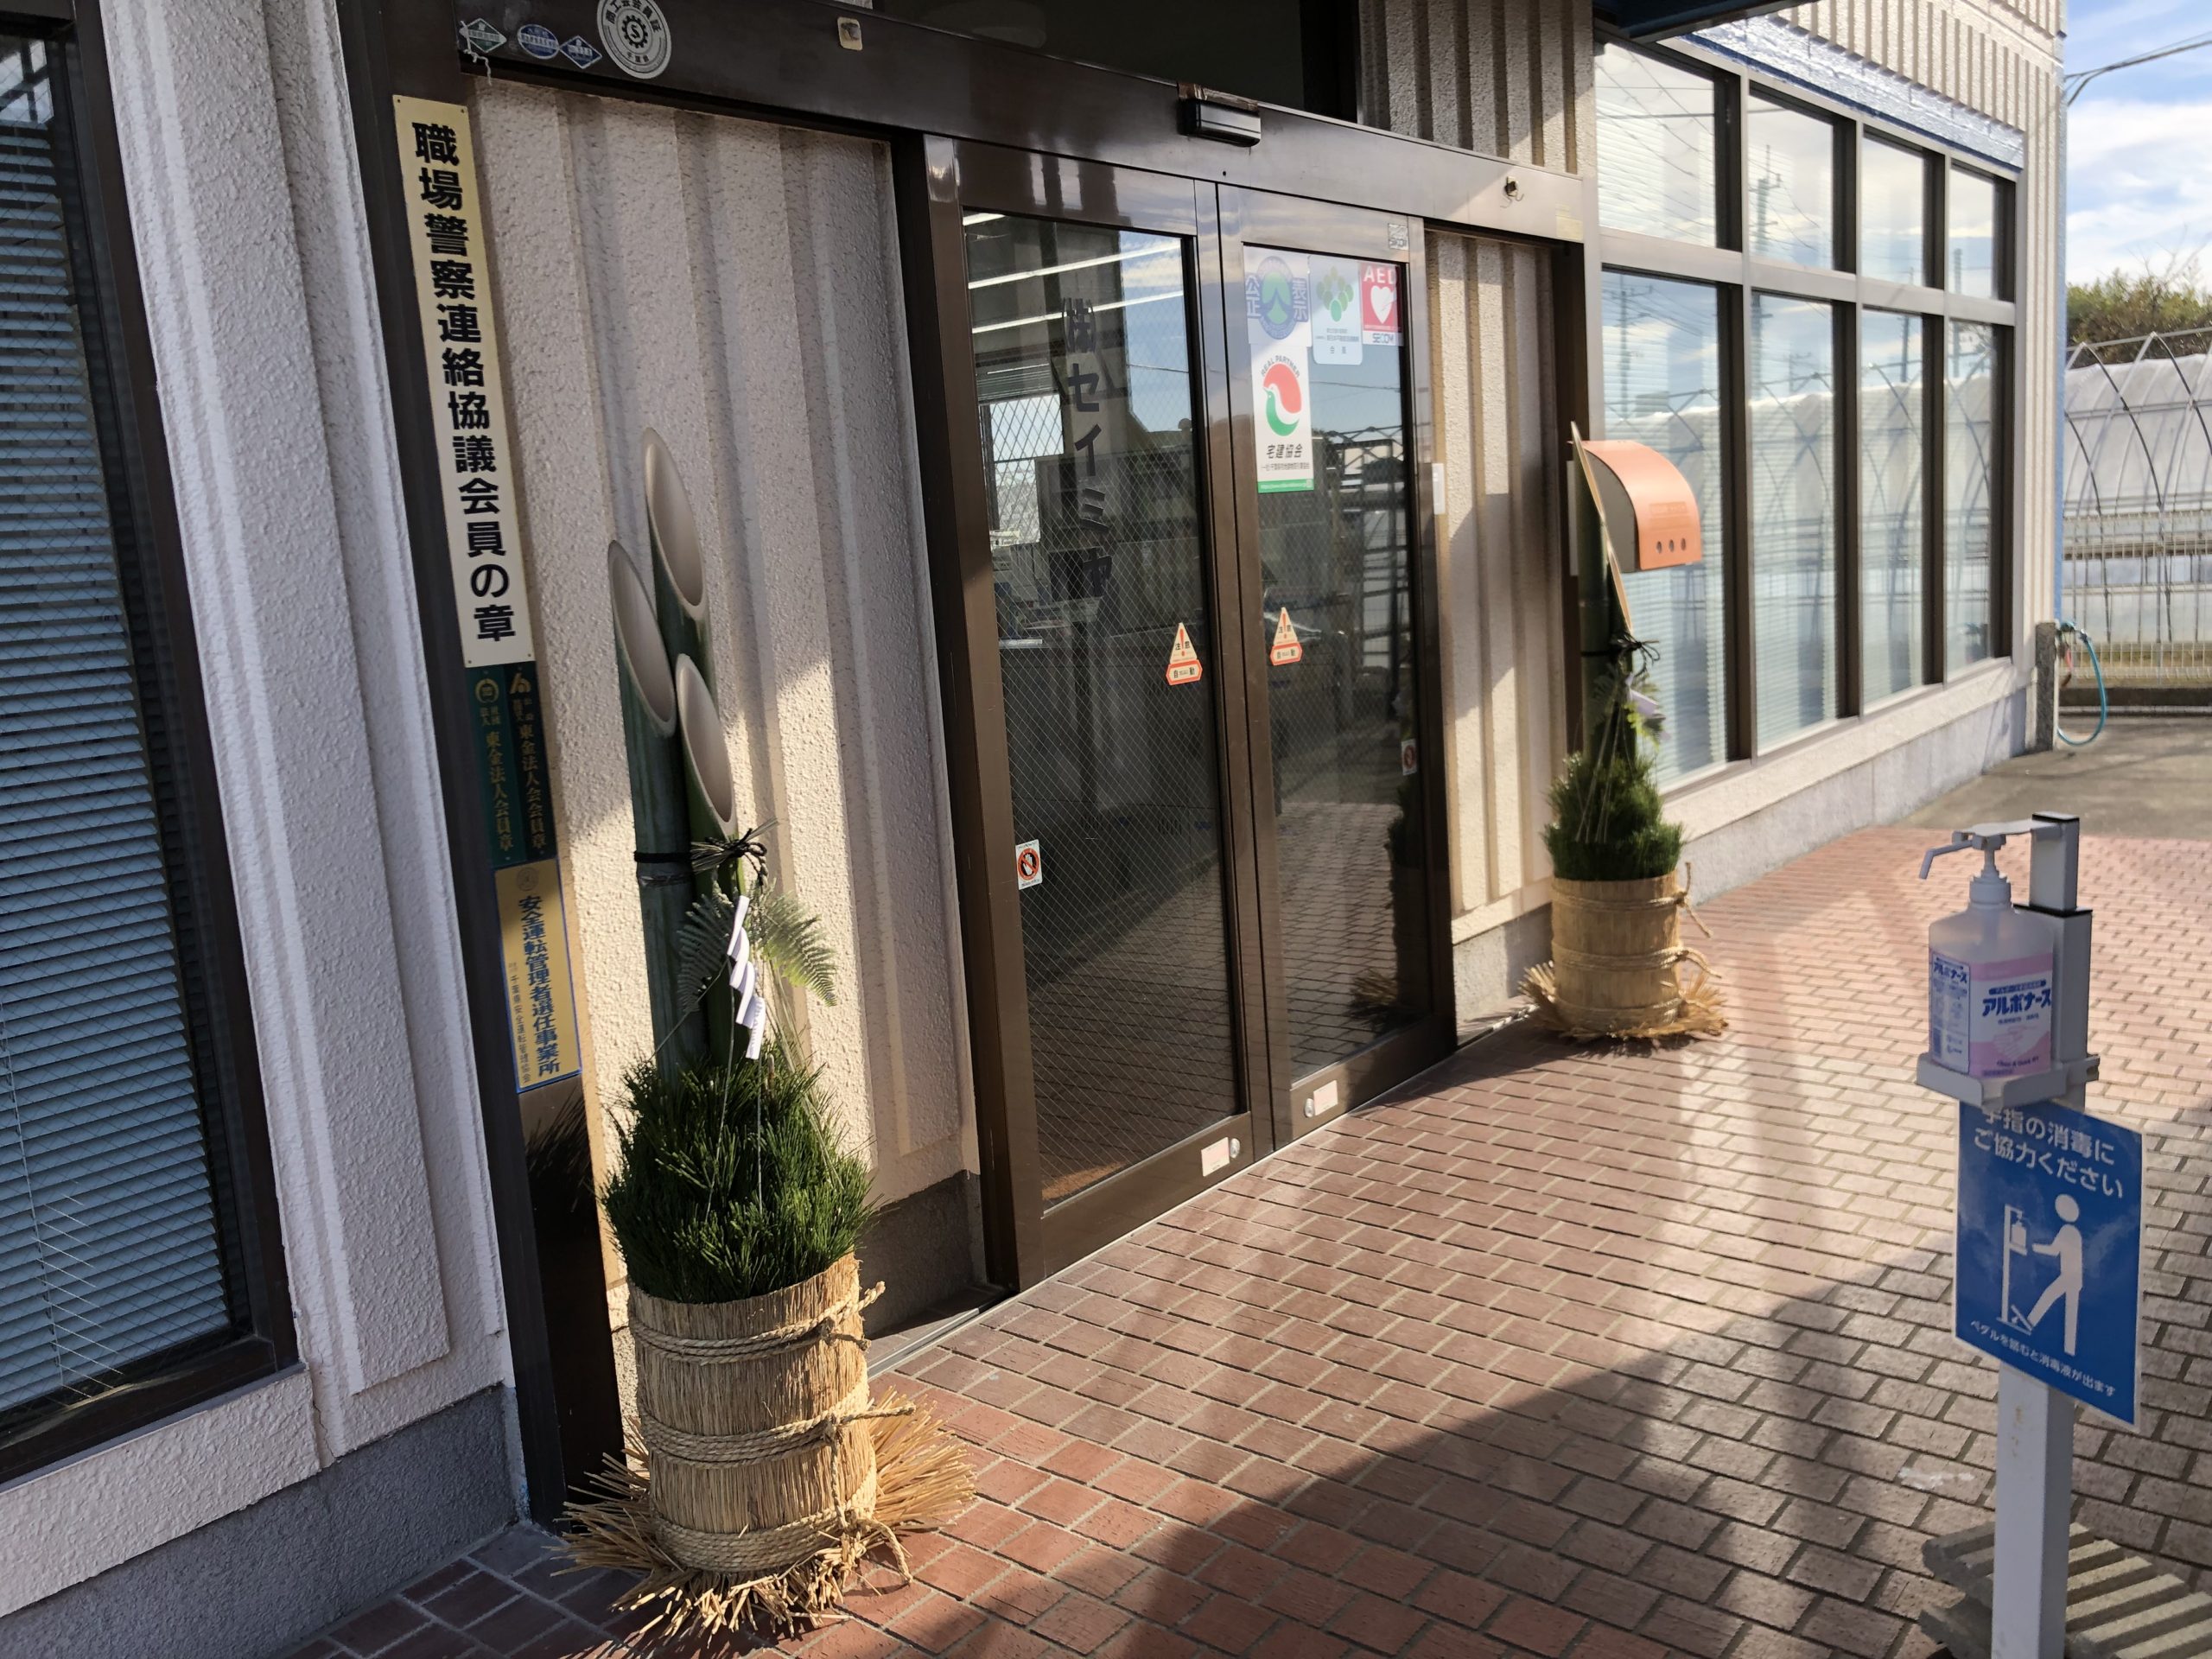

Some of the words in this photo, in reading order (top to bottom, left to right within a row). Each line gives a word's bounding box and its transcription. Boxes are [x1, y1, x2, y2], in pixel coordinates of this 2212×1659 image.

[411, 122, 516, 642] 職場警察連絡協議会員の章
[519, 895, 561, 1077] 安全運転管理者選任事業所
[1982, 988, 2052, 1018] アルボナース
[1974, 1127, 2123, 1199] ご協力ください
[1970, 1319, 2116, 1397] ペダルを踏むと消毒液が出ます
